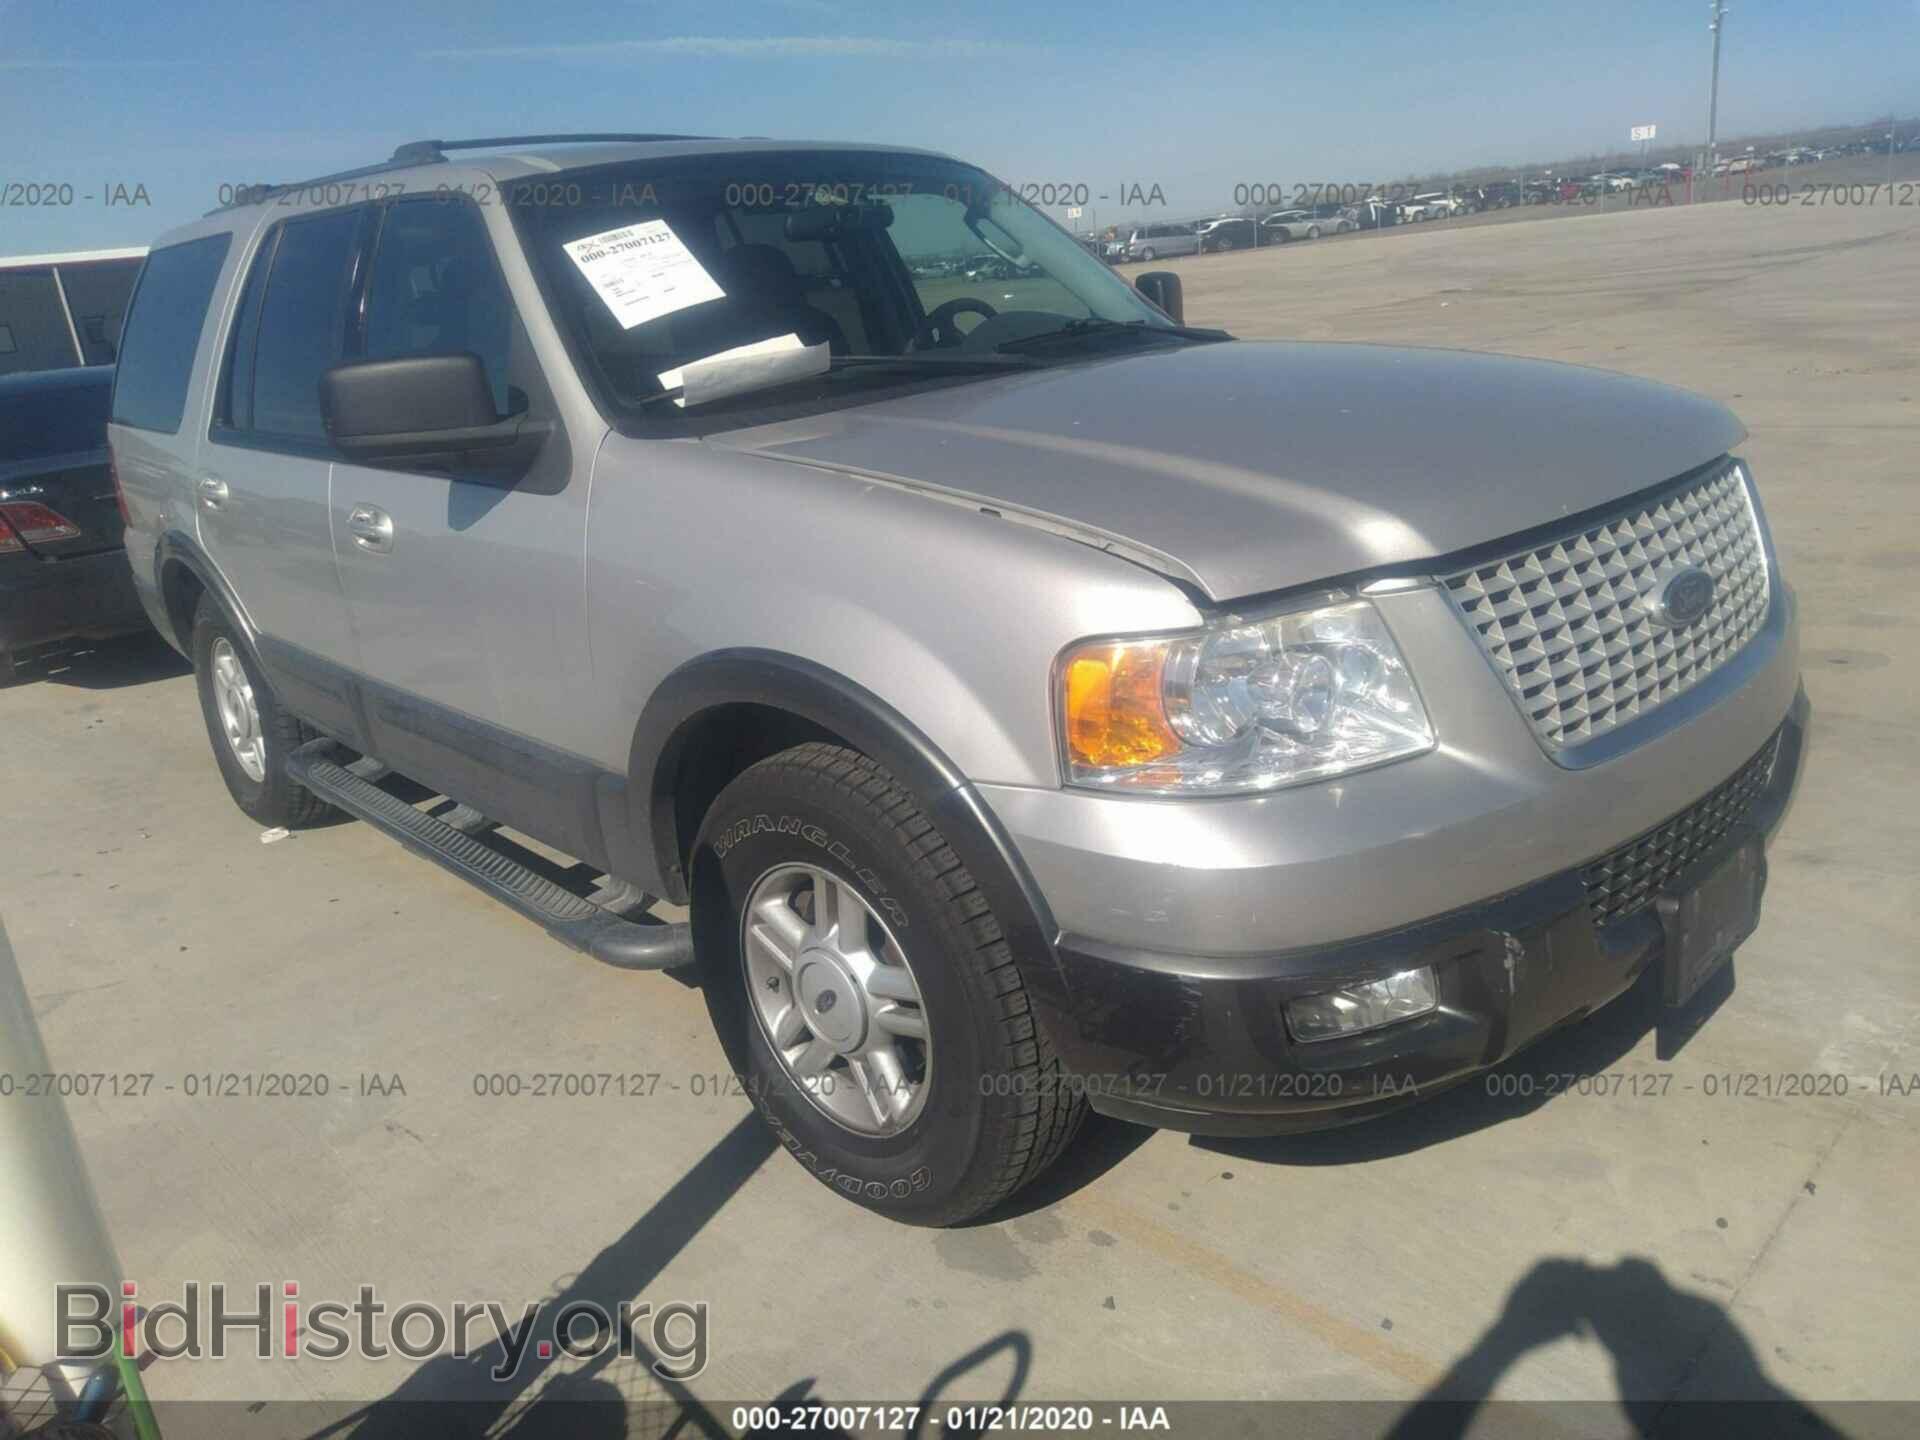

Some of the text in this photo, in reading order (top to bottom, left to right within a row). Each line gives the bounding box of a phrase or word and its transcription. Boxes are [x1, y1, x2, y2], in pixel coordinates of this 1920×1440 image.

[580, 232, 671, 263] 000-27007127
[713, 814, 909, 928] WRANGLER
[757, 1096, 931, 1200] GOODYE
